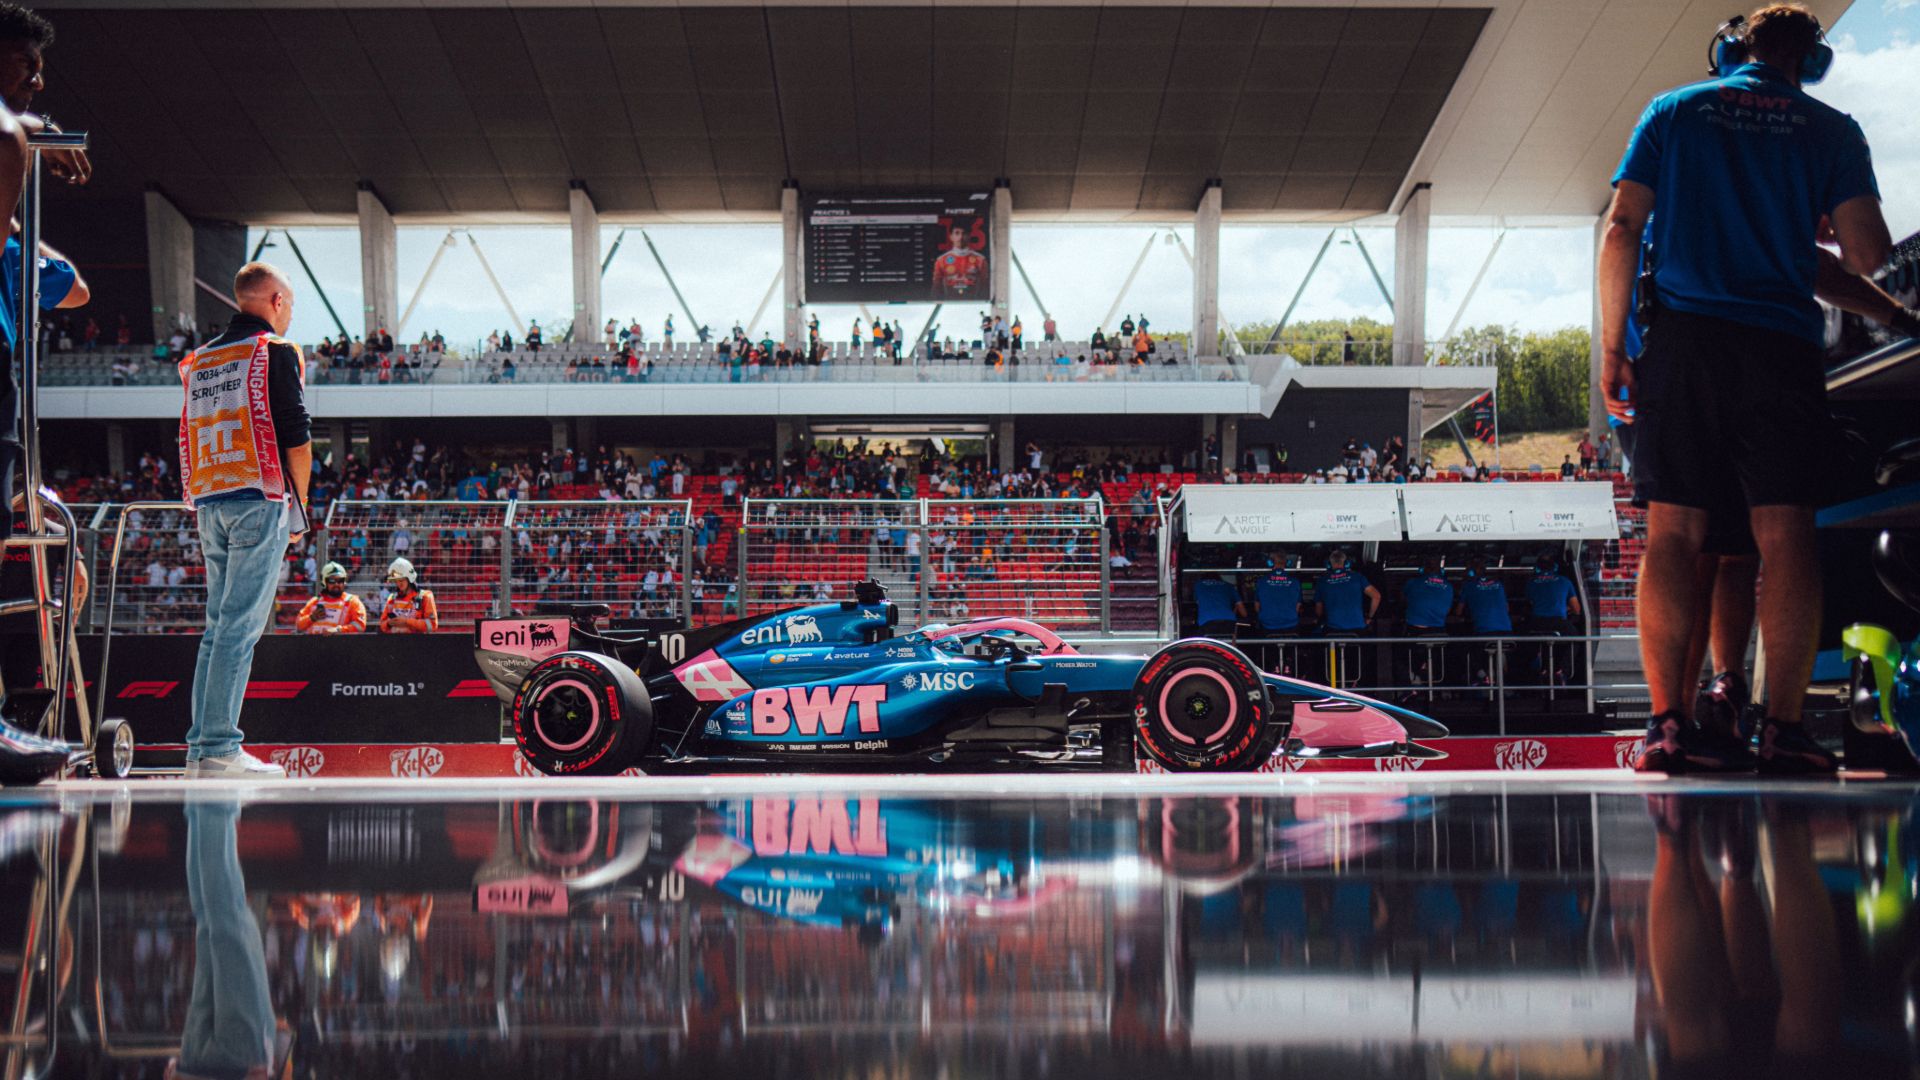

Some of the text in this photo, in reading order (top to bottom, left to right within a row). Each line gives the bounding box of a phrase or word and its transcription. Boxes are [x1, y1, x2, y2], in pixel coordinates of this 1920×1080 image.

[1697, 103, 1808, 125] ALPINE
[197, 419, 243, 458] PIT
[1234, 515, 1271, 525] ARCTIC
[1336, 514, 1357, 522] BWT
[1455, 513, 1492, 523] ARCTIC
[1553, 513, 1575, 521] BWT
[1241, 525, 1269, 534] WOLF
[1460, 523, 1490, 533] WOLF
[490, 625, 525, 646] eni
[741, 620, 782, 645] eni
[660, 633, 686, 665] 10
[331, 682, 404, 697] Formula
[920, 672, 975, 691] MSC
[752, 684, 887, 736] BWT
[855, 740, 888, 751] Delphi
[1502, 740, 1545, 770] KitKat
[397, 748, 441, 778] KitKat
